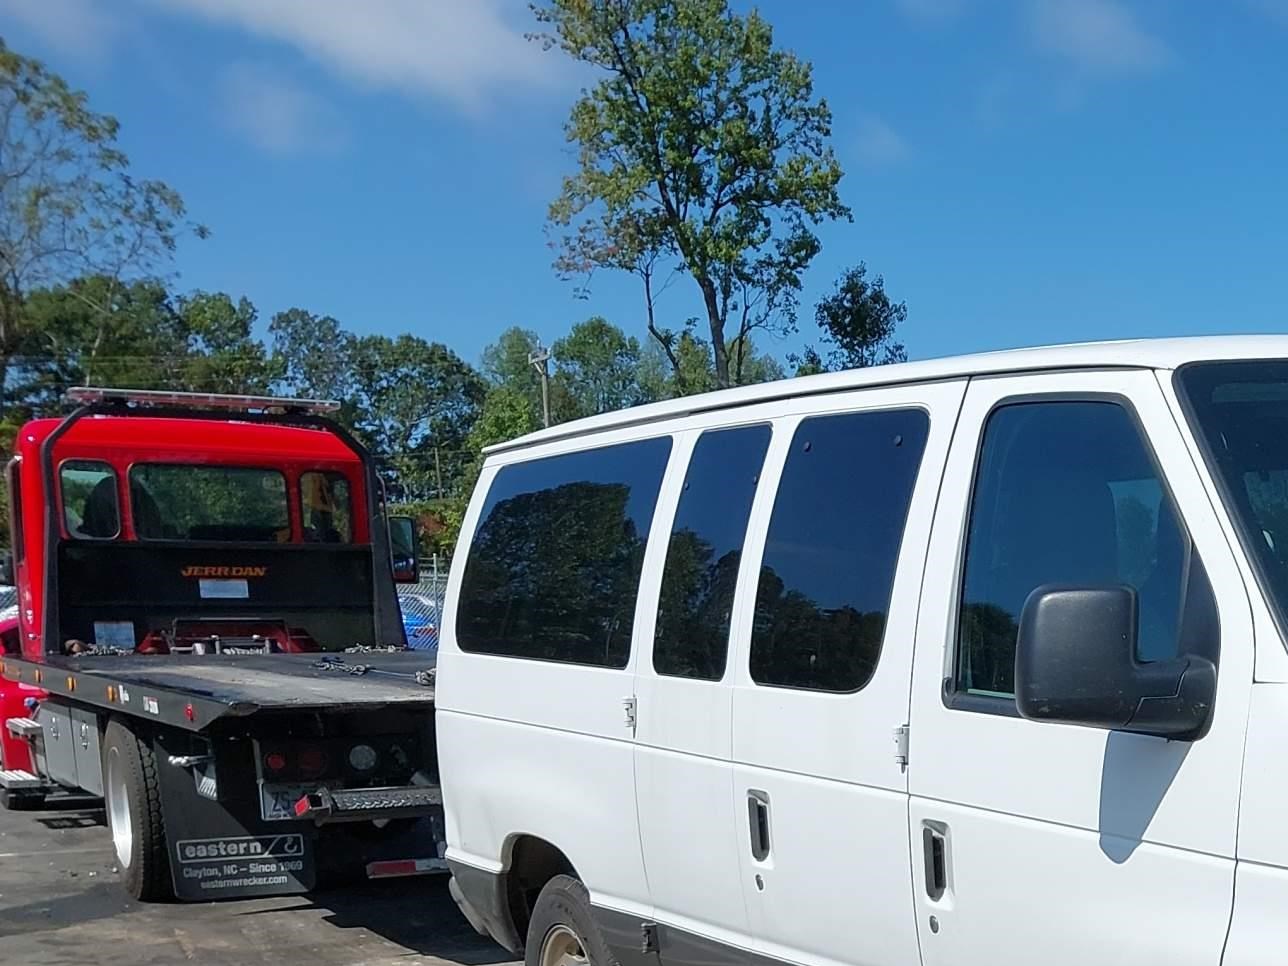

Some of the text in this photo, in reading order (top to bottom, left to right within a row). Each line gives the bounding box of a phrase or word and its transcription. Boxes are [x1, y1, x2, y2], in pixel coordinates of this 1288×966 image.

[184, 841, 262, 858] eastern
[183, 867, 222, 879] Clayton,
[223, 864, 238, 876] NC
[249, 862, 277, 874] Since
[200, 875, 288, 889] easternwrecker.com
